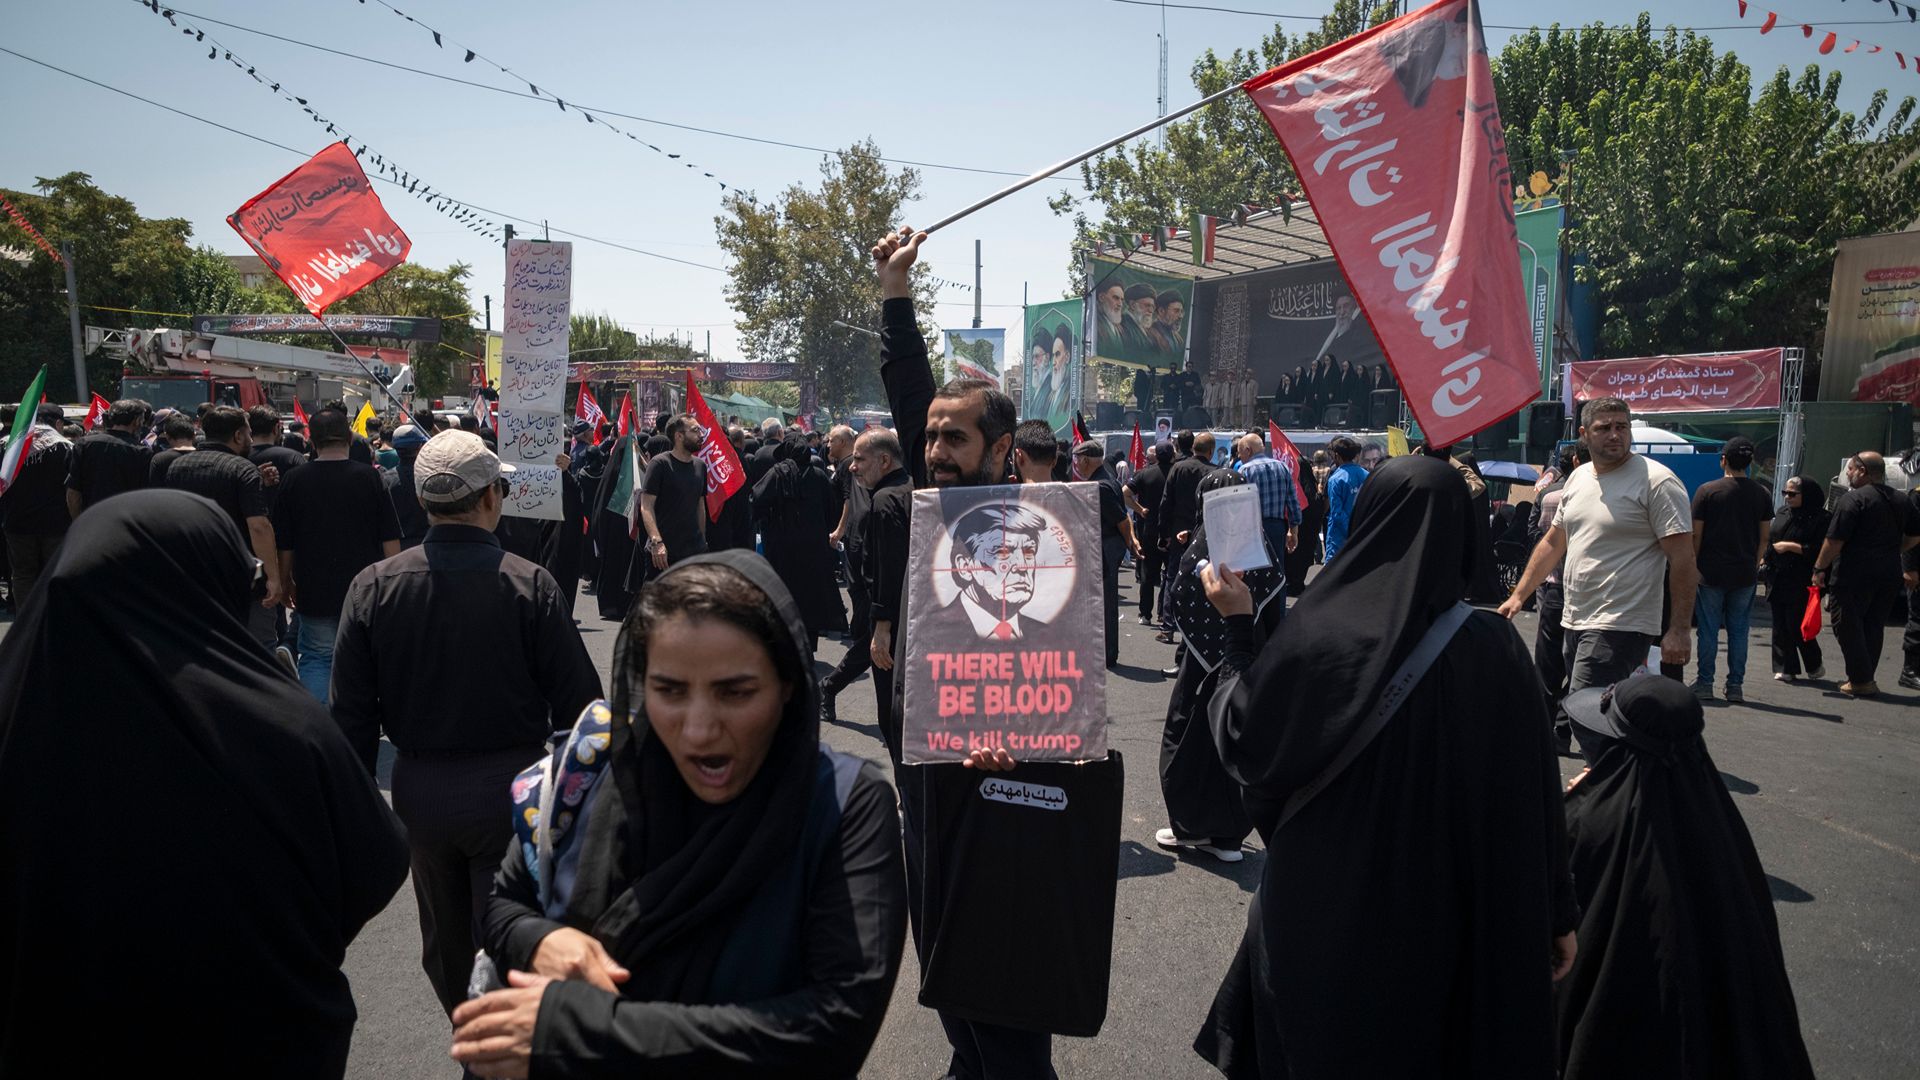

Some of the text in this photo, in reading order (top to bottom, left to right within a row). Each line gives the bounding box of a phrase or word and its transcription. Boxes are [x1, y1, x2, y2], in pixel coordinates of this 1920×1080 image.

[1608, 366, 1735, 385] ستاد گمشدگان و بحران
[1650, 384, 1699, 400] الرضای
[1701, 384, 1729, 399] باب
[926, 651, 1084, 682] THERE WILL
[938, 684, 1073, 718] BE BLOOD
[927, 730, 1082, 753] We kill trump
